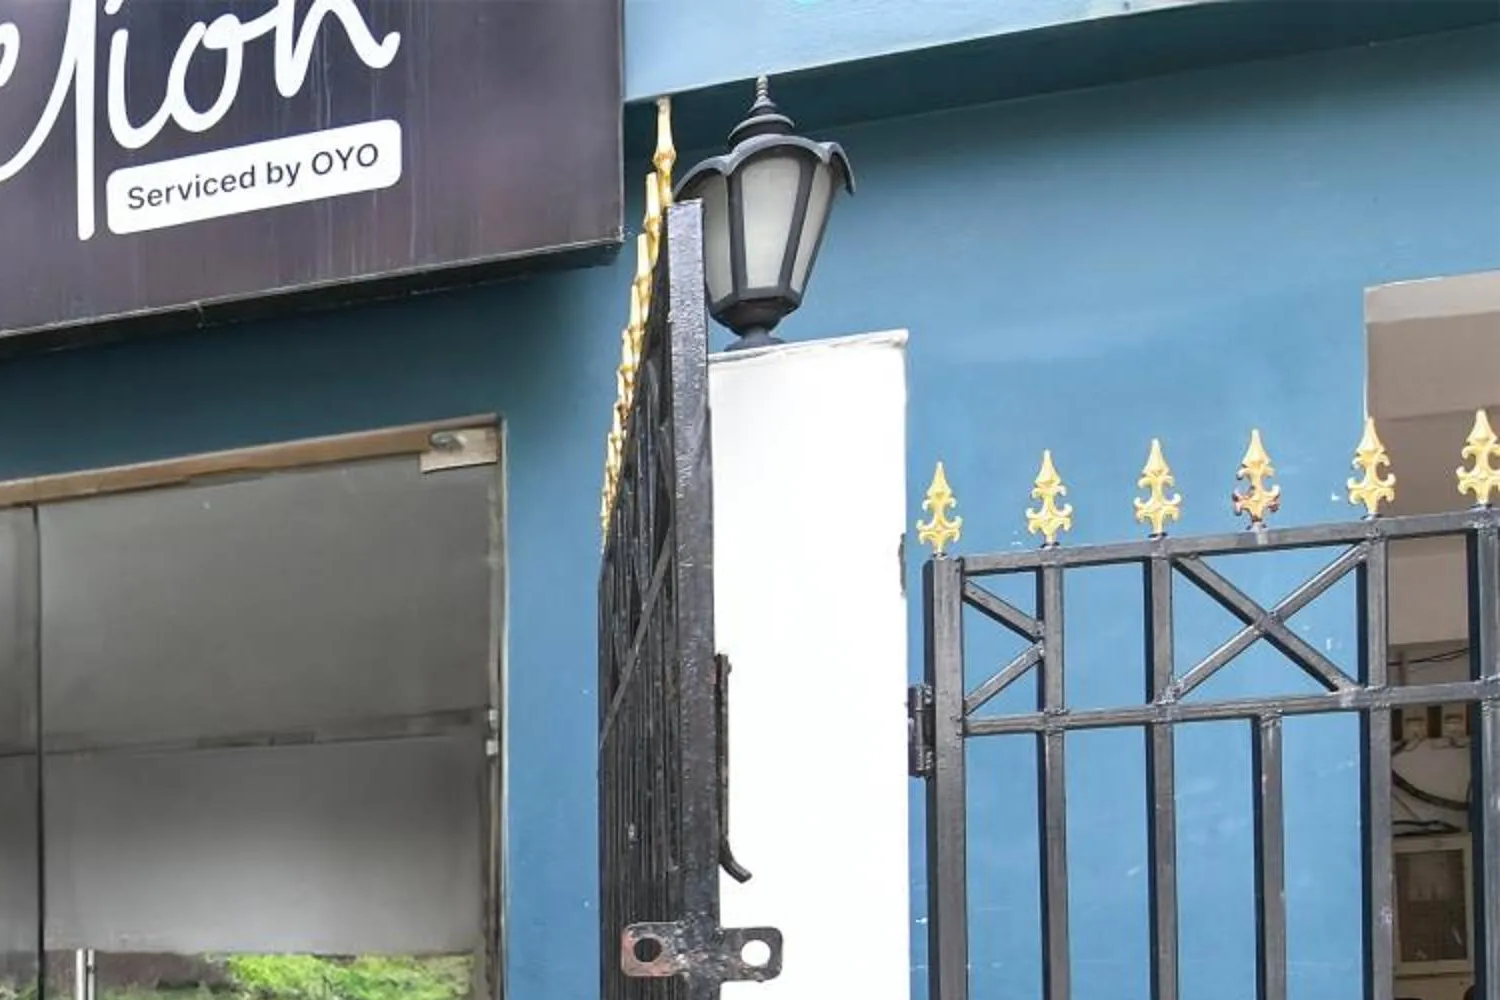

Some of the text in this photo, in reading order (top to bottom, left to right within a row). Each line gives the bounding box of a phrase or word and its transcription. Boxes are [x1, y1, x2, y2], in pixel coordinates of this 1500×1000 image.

[127, 143, 379, 210] Serviced by OYO
